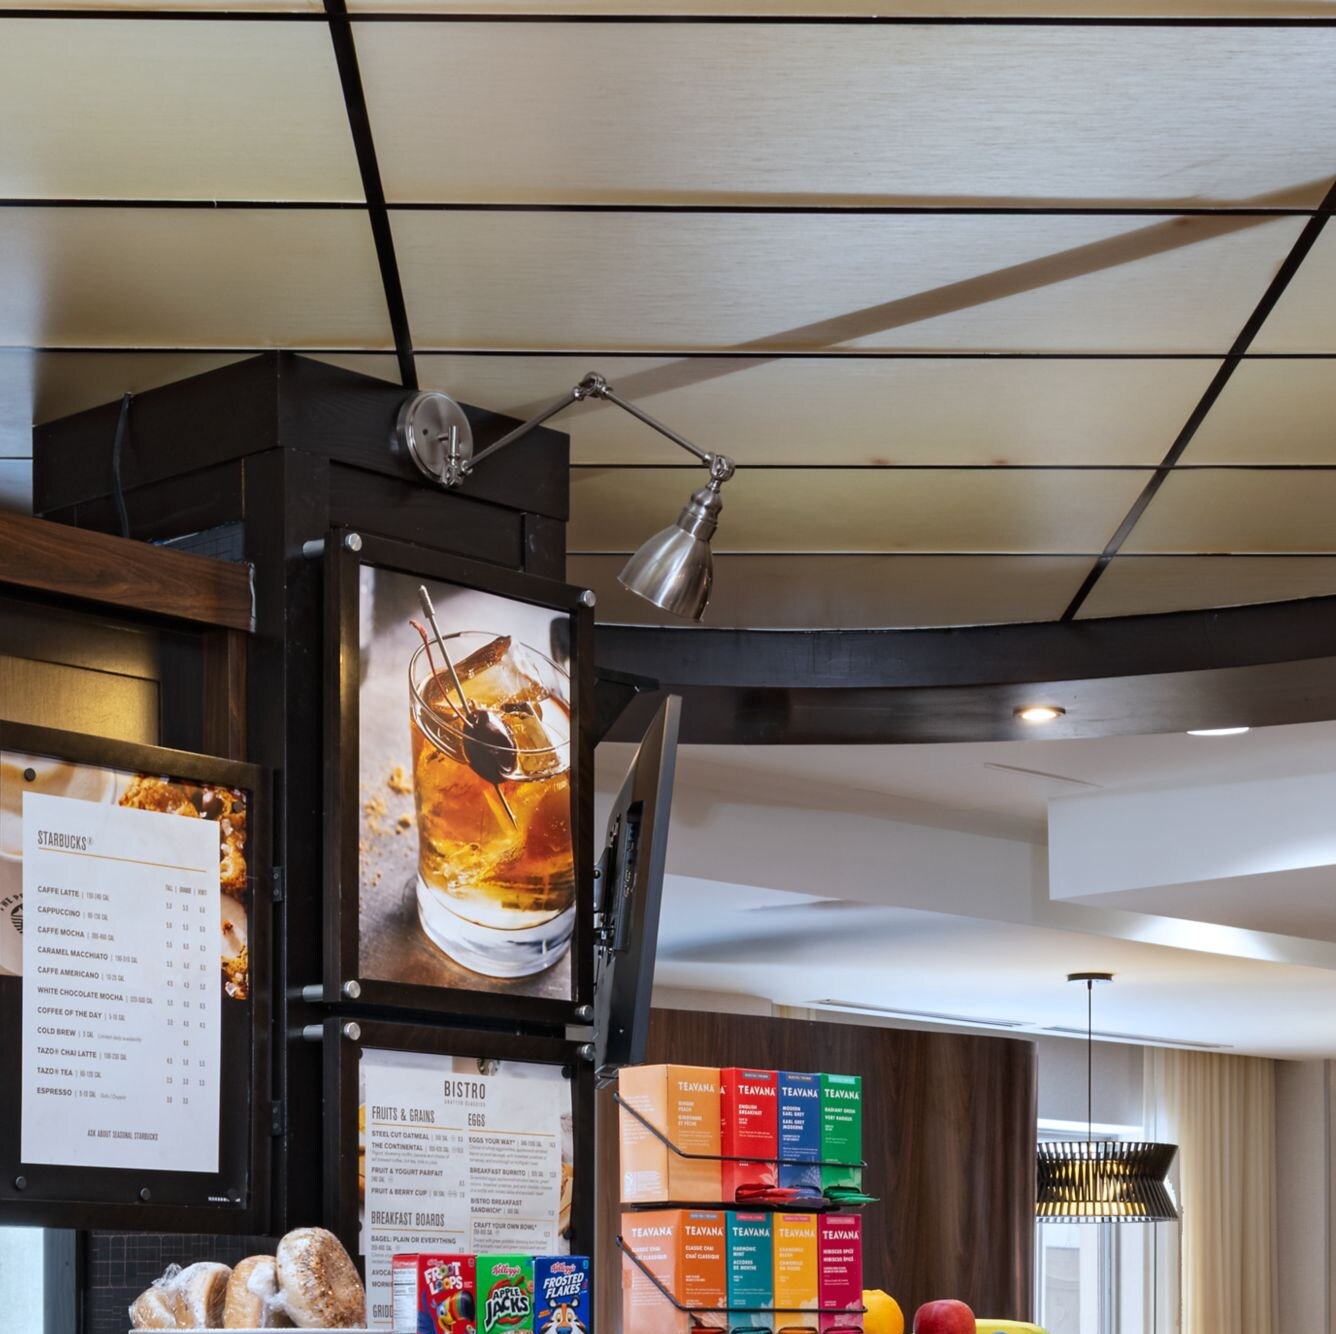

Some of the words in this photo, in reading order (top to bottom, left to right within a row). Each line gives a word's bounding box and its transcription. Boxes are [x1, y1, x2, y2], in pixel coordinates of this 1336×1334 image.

[38, 886, 59, 895] CAFFE
[60, 888, 80, 898] LATTE
[38, 906, 81, 918] CAPPUCCINO
[38, 926, 59, 935] CAFFE
[60, 928, 85, 938] MOCHA
[38, 946, 69, 956] CARAMEL
[70, 950, 109, 961] MACCHIATO
[38, 966, 59, 975] CAFFE
[60, 969, 100, 980] AMERICANO
[38, 986, 59, 996] WHITE
[60, 988, 99, 999] CHOCOLATE
[100, 992, 124, 1002] MOCHA
[37, 1006, 64, 1016] COFFEE
[64, 1009, 74, 1017] OF
[75, 1010, 88, 1018] THE
[89, 1011, 102, 1020] DAY
[37, 1027, 55, 1036] COLD
[56, 1029, 76, 1037] BREW
[60, 1048, 77, 1057] CHAI
[78, 1050, 97, 1059] LATTE
[60, 1068, 73, 1077] TEA
[37, 1087, 73, 1097] ESPRESSO
[444, 1080, 486, 1100] BISTRO
[678, 1081, 715, 1093] TEAVANA
[738, 1085, 775, 1097] TEAVANA
[782, 1087, 818, 1098] TEAVANA
[824, 1088, 859, 1100] TEAVANA
[372, 1105, 398, 1121] FRUITS
[400, 1108, 407, 1121] &
[409, 1108, 435, 1123] GRAINS
[468, 1112, 486, 1127] EGGS
[371, 1130, 389, 1138] STEEL
[390, 1131, 402, 1139] CUT
[403, 1132, 429, 1141] OATMEAL
[384, 1143, 423, 1151] CONTINENTAL
[395, 1168, 418, 1176] YOGURT
[419, 1169, 443, 1177] PARFAIT
[470, 1167, 501, 1176] BREAKFAST
[502, 1169, 526, 1177] BURRITO
[394, 1188, 414, 1197] BERRY
[414, 1189, 427, 1197] CUP
[470, 1198, 491, 1206] BISTRO
[491, 1199, 522, 1207] BREAKFAST
[371, 1210, 412, 1226] BREAKFAST
[415, 1212, 445, 1228] BOARDS
[632, 1227, 672, 1238] TEAVANA
[685, 1226, 723, 1237] TEAVANA
[732, 1227, 770, 1237] TEAVANA
[779, 1228, 816, 1238] TEAVANA
[823, 1230, 859, 1240] TEAVANA
[420, 1237, 456, 1245] EVERYTHING
[424, 1261, 462, 1284] FROOT
[429, 1275, 463, 1296] LOOPS
[543, 1272, 584, 1290] FROSTED
[493, 1287, 520, 1300] APPLE
[545, 1283, 581, 1299] FLAKES
[485, 1296, 529, 1331] JACKS
